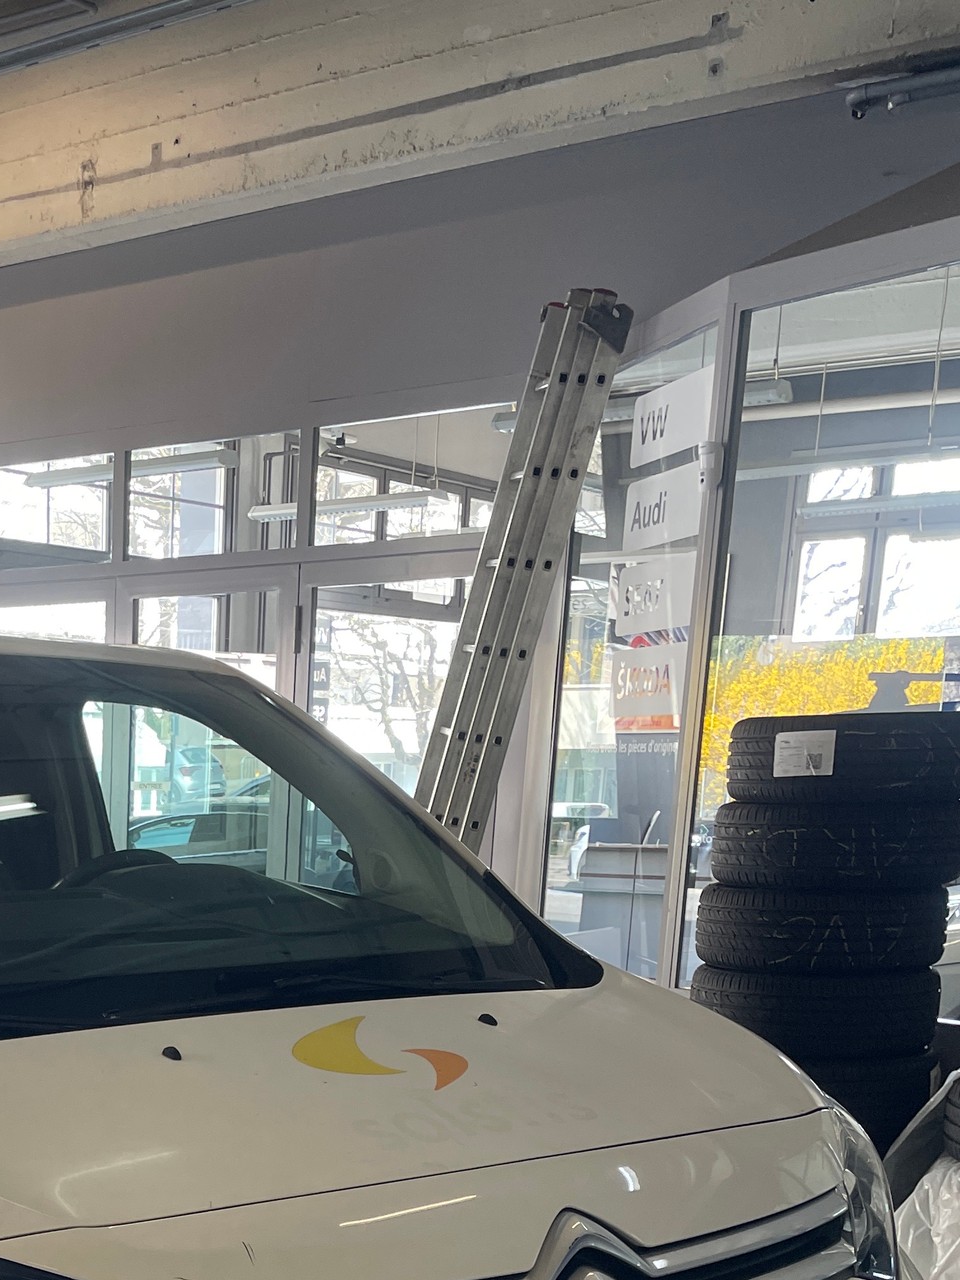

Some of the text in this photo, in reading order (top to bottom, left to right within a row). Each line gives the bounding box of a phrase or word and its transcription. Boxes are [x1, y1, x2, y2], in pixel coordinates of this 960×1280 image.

[640, 404, 669, 446] VW
[630, 490, 668, 532] Audi
[623, 578, 664, 617] SEAT
